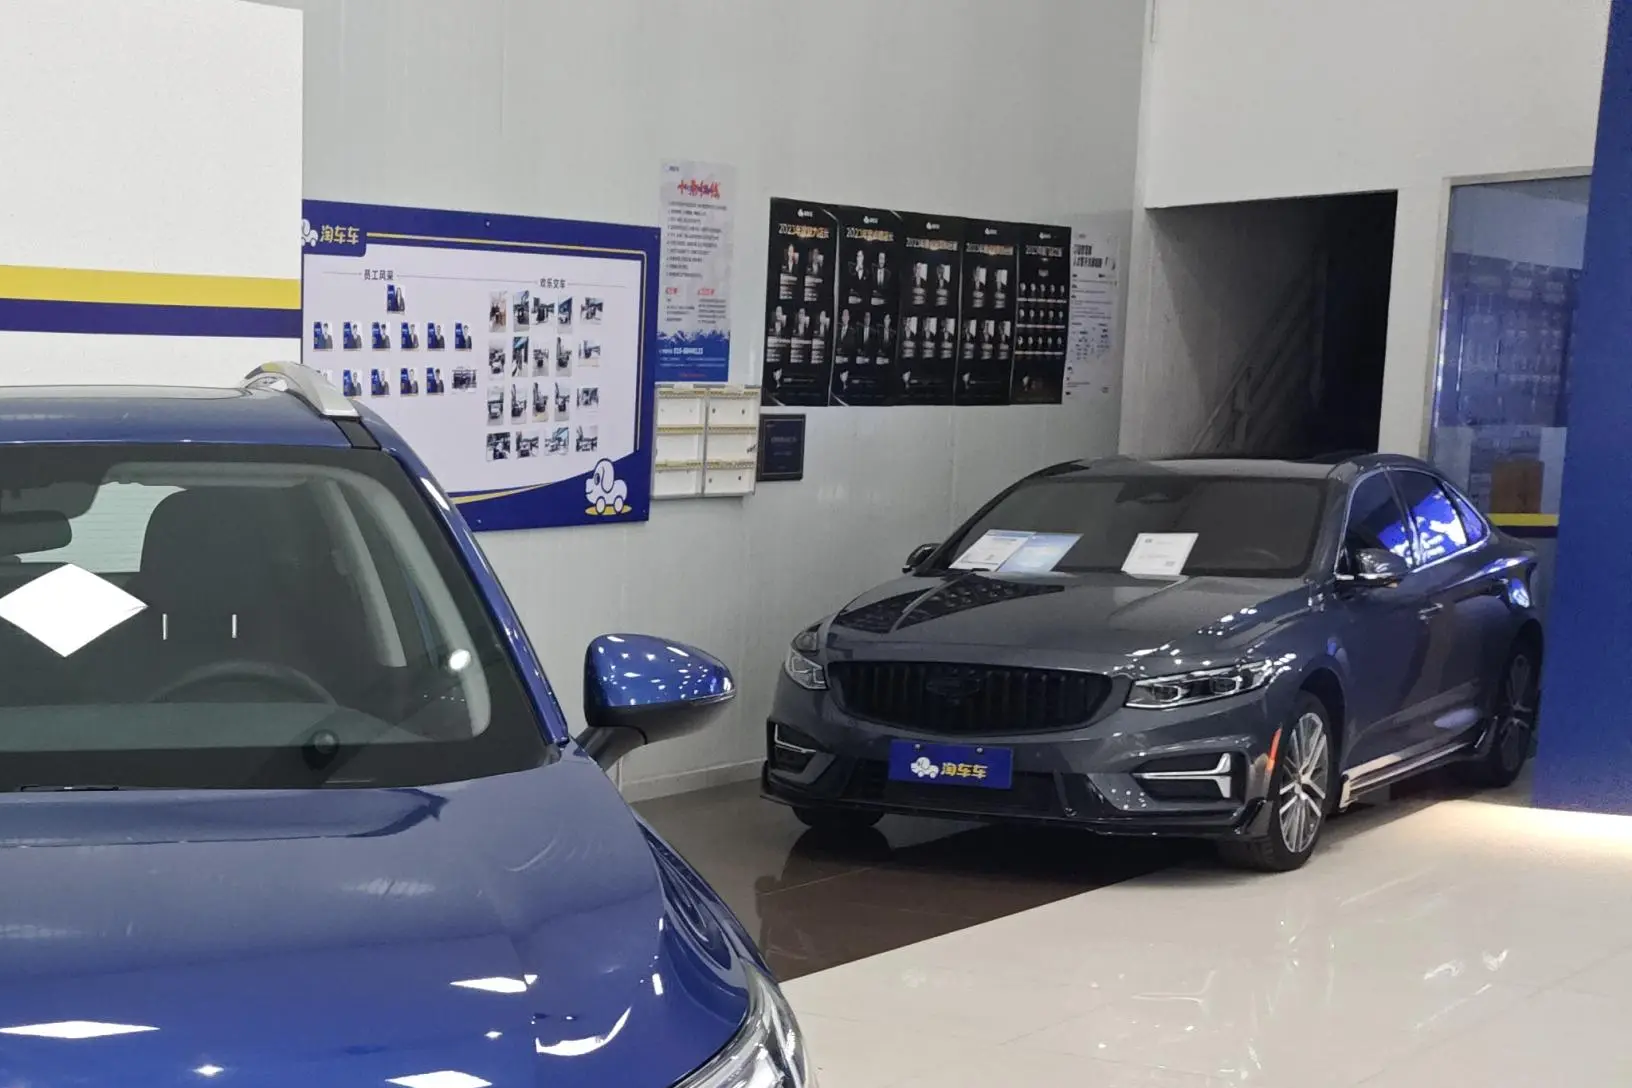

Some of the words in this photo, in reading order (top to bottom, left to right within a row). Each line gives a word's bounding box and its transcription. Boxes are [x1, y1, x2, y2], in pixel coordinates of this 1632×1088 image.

[319, 224, 360, 245] 淘车车
[364, 269, 394, 281] 员工风采
[940, 762, 988, 779] 淘车车
